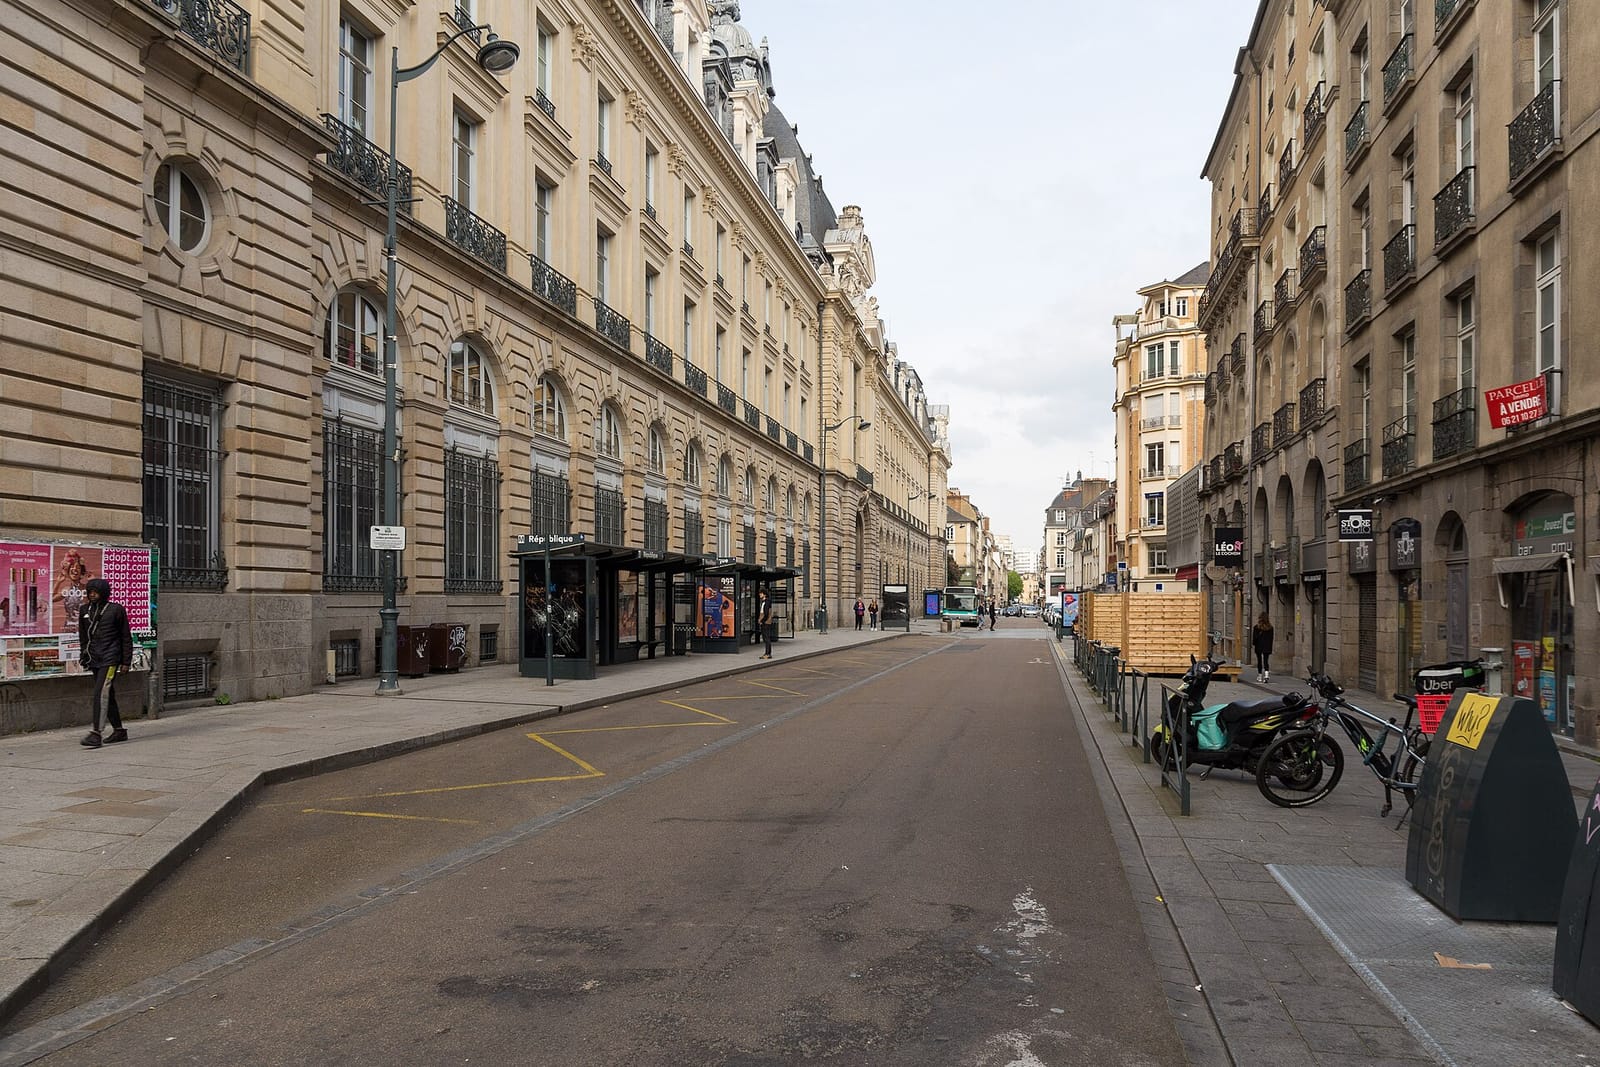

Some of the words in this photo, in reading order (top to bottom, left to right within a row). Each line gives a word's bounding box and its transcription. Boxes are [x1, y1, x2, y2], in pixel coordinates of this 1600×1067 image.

[1488, 377, 1544, 401] PARCELLE
[1499, 402, 1508, 416] À
[1507, 394, 1542, 413] VENDRE
[1511, 414, 1520, 424] 21
[1520, 411, 1529, 421] 10
[1529, 409, 1538, 419] 27
[1341, 518, 1371, 528] STORE
[528, 534, 573, 545] Répblique
[1518, 543, 1533, 556] bar
[1551, 541, 1573, 554] pmu
[104, 553, 150, 562] adopt.com
[104, 562, 150, 571] adopt.com
[104, 571, 150, 580] adopt.com
[109, 580, 150, 589] dopt.com
[62, 586, 87, 600] adop
[1423, 679, 1453, 691] Uber
